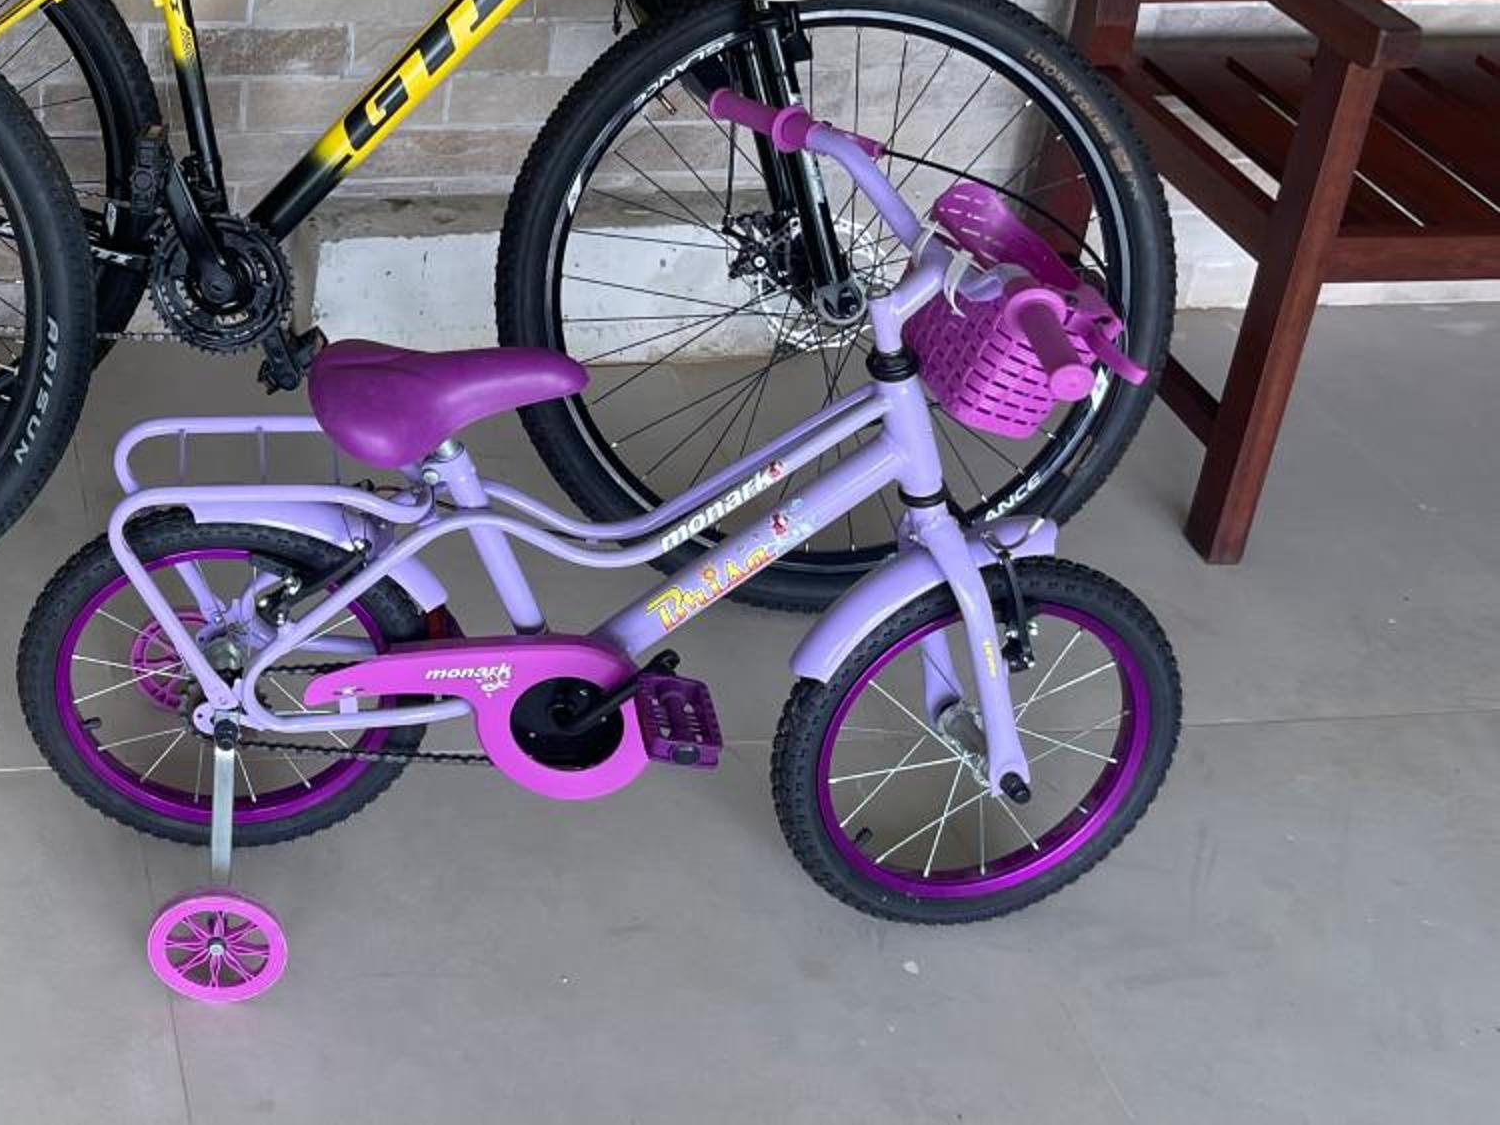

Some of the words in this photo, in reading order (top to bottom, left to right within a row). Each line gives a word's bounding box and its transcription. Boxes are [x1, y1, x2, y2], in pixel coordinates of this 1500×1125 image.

[1025, 48, 1076, 93] LEVORIN
[13, 314, 60, 466] ARISUN
[661, 470, 775, 554] monark
[424, 661, 512, 681] monark
